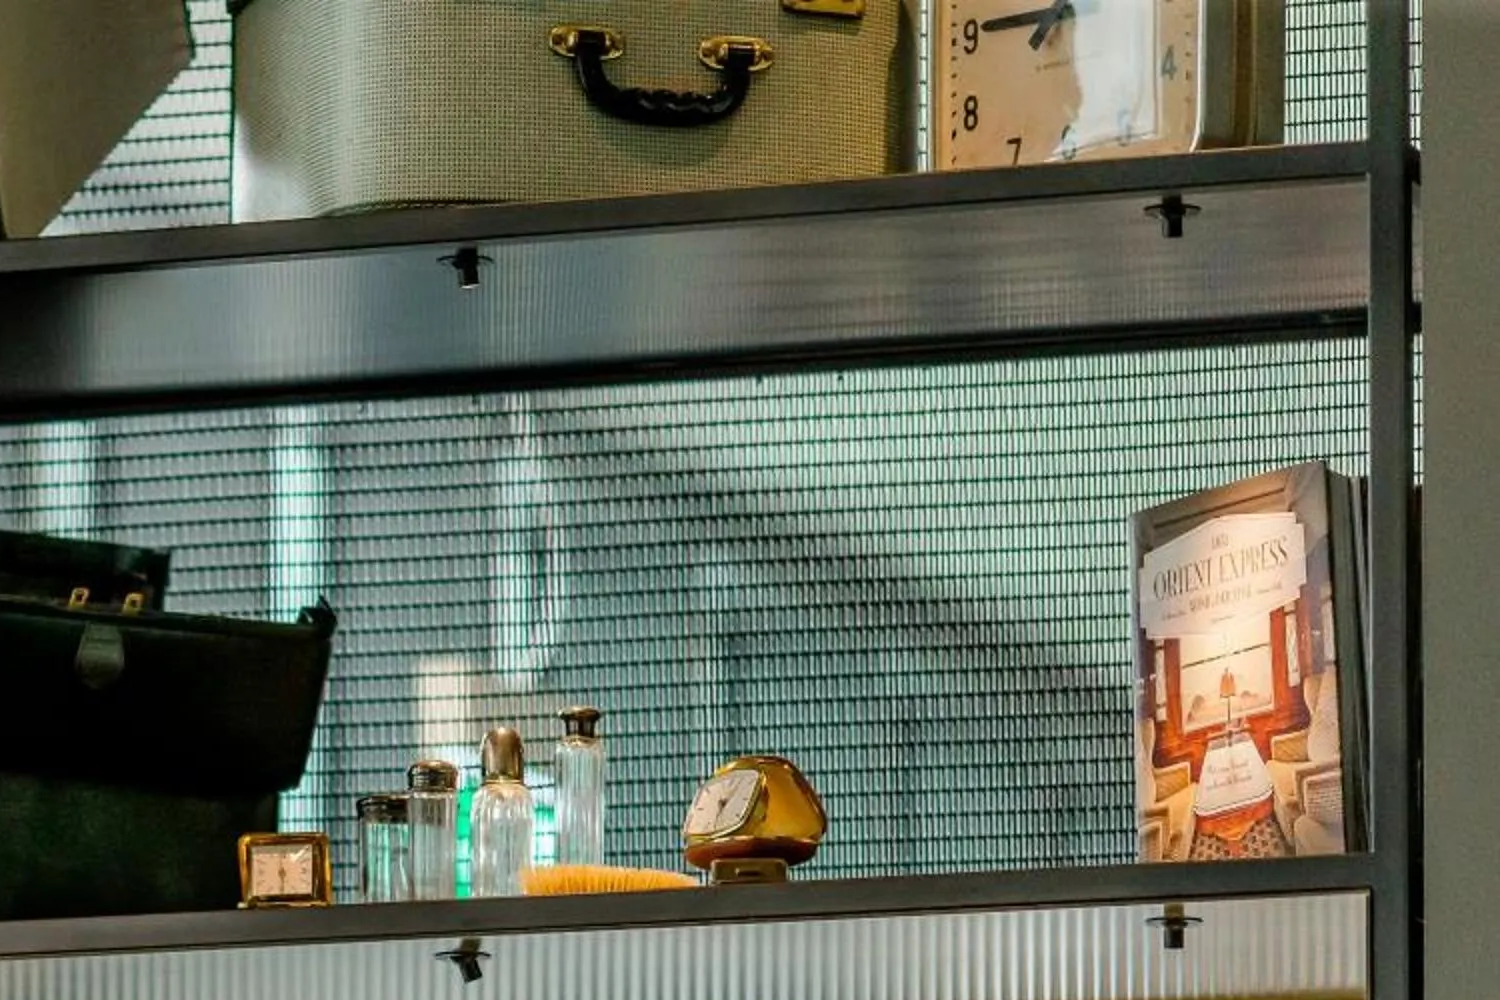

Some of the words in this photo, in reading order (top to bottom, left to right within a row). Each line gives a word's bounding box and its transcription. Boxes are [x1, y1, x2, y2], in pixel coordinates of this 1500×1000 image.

[963, 19, 978, 54] 9
[1161, 46, 1177, 81] 4
[963, 95, 978, 131] 8
[1006, 137, 1022, 165] 7
[1153, 557, 1213, 601] ORIENT
[1219, 535, 1289, 584] EXPRESS
